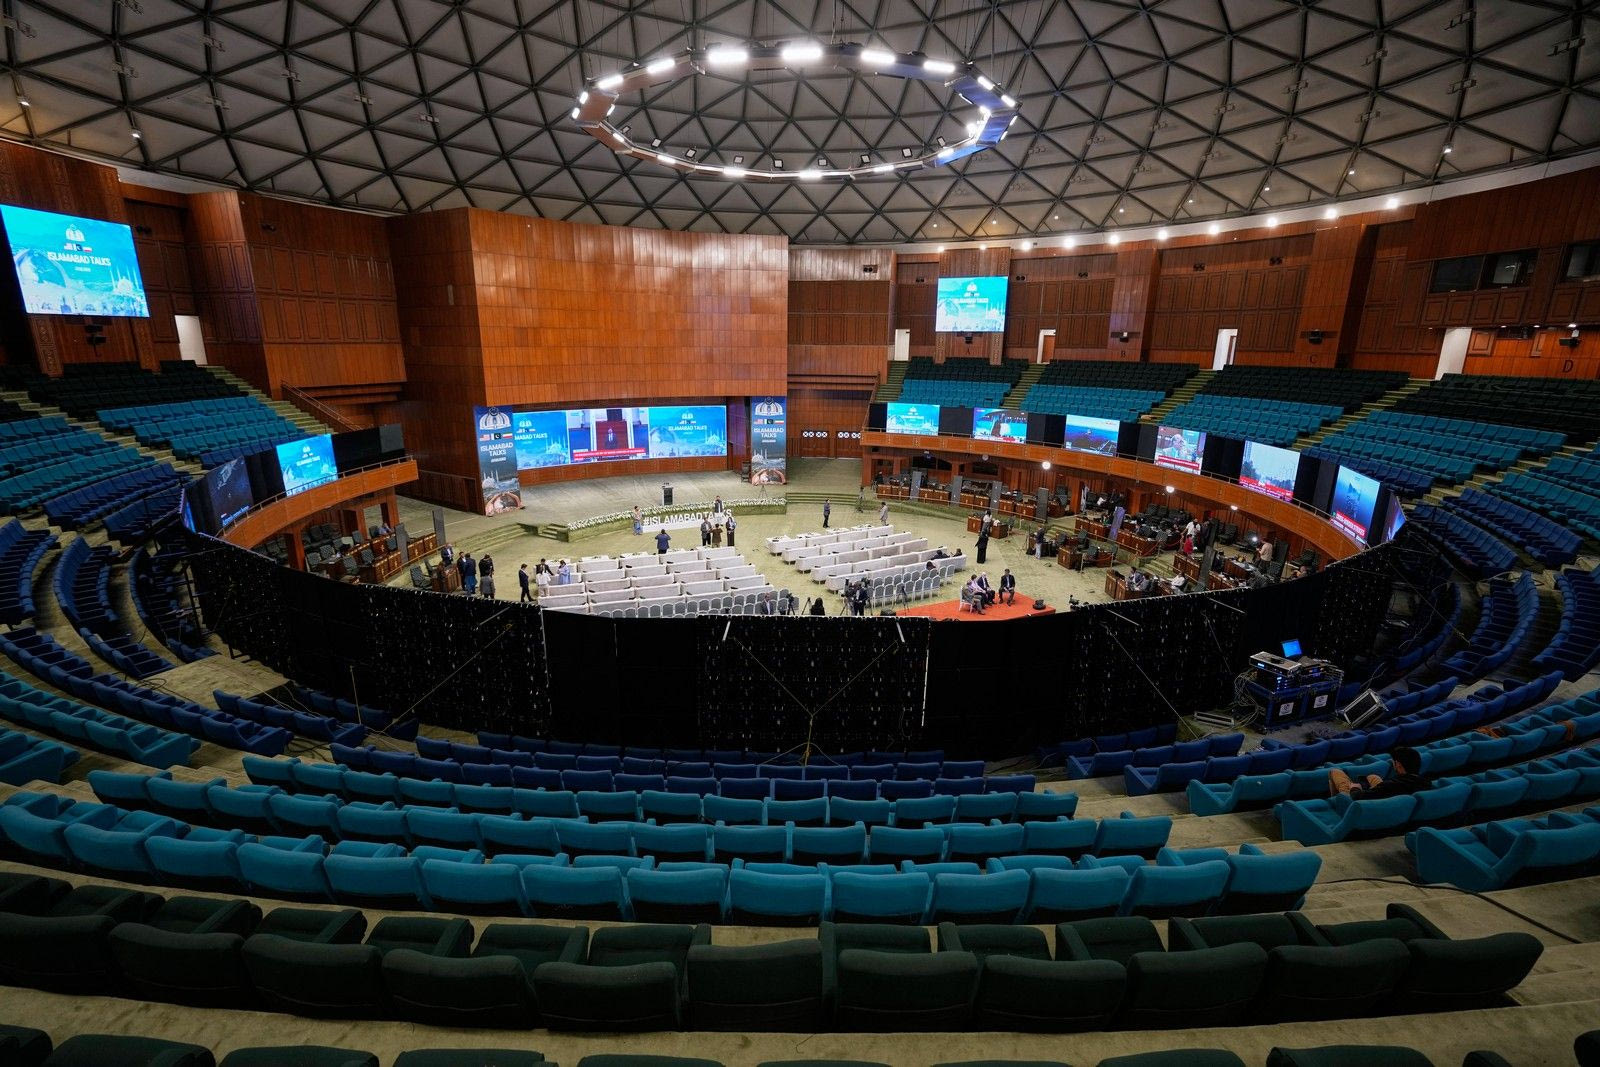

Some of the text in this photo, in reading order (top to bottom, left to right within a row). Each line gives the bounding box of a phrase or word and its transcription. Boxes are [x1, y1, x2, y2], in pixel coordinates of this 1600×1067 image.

[47, 251, 111, 266] ISLAMABAD TALKS
[1562, 359, 1574, 373] D
[480, 442, 514, 452] ISLAMABAD
[489, 449, 507, 457] TALKS
[643, 508, 732, 526] #ISLAMABADTAKS
